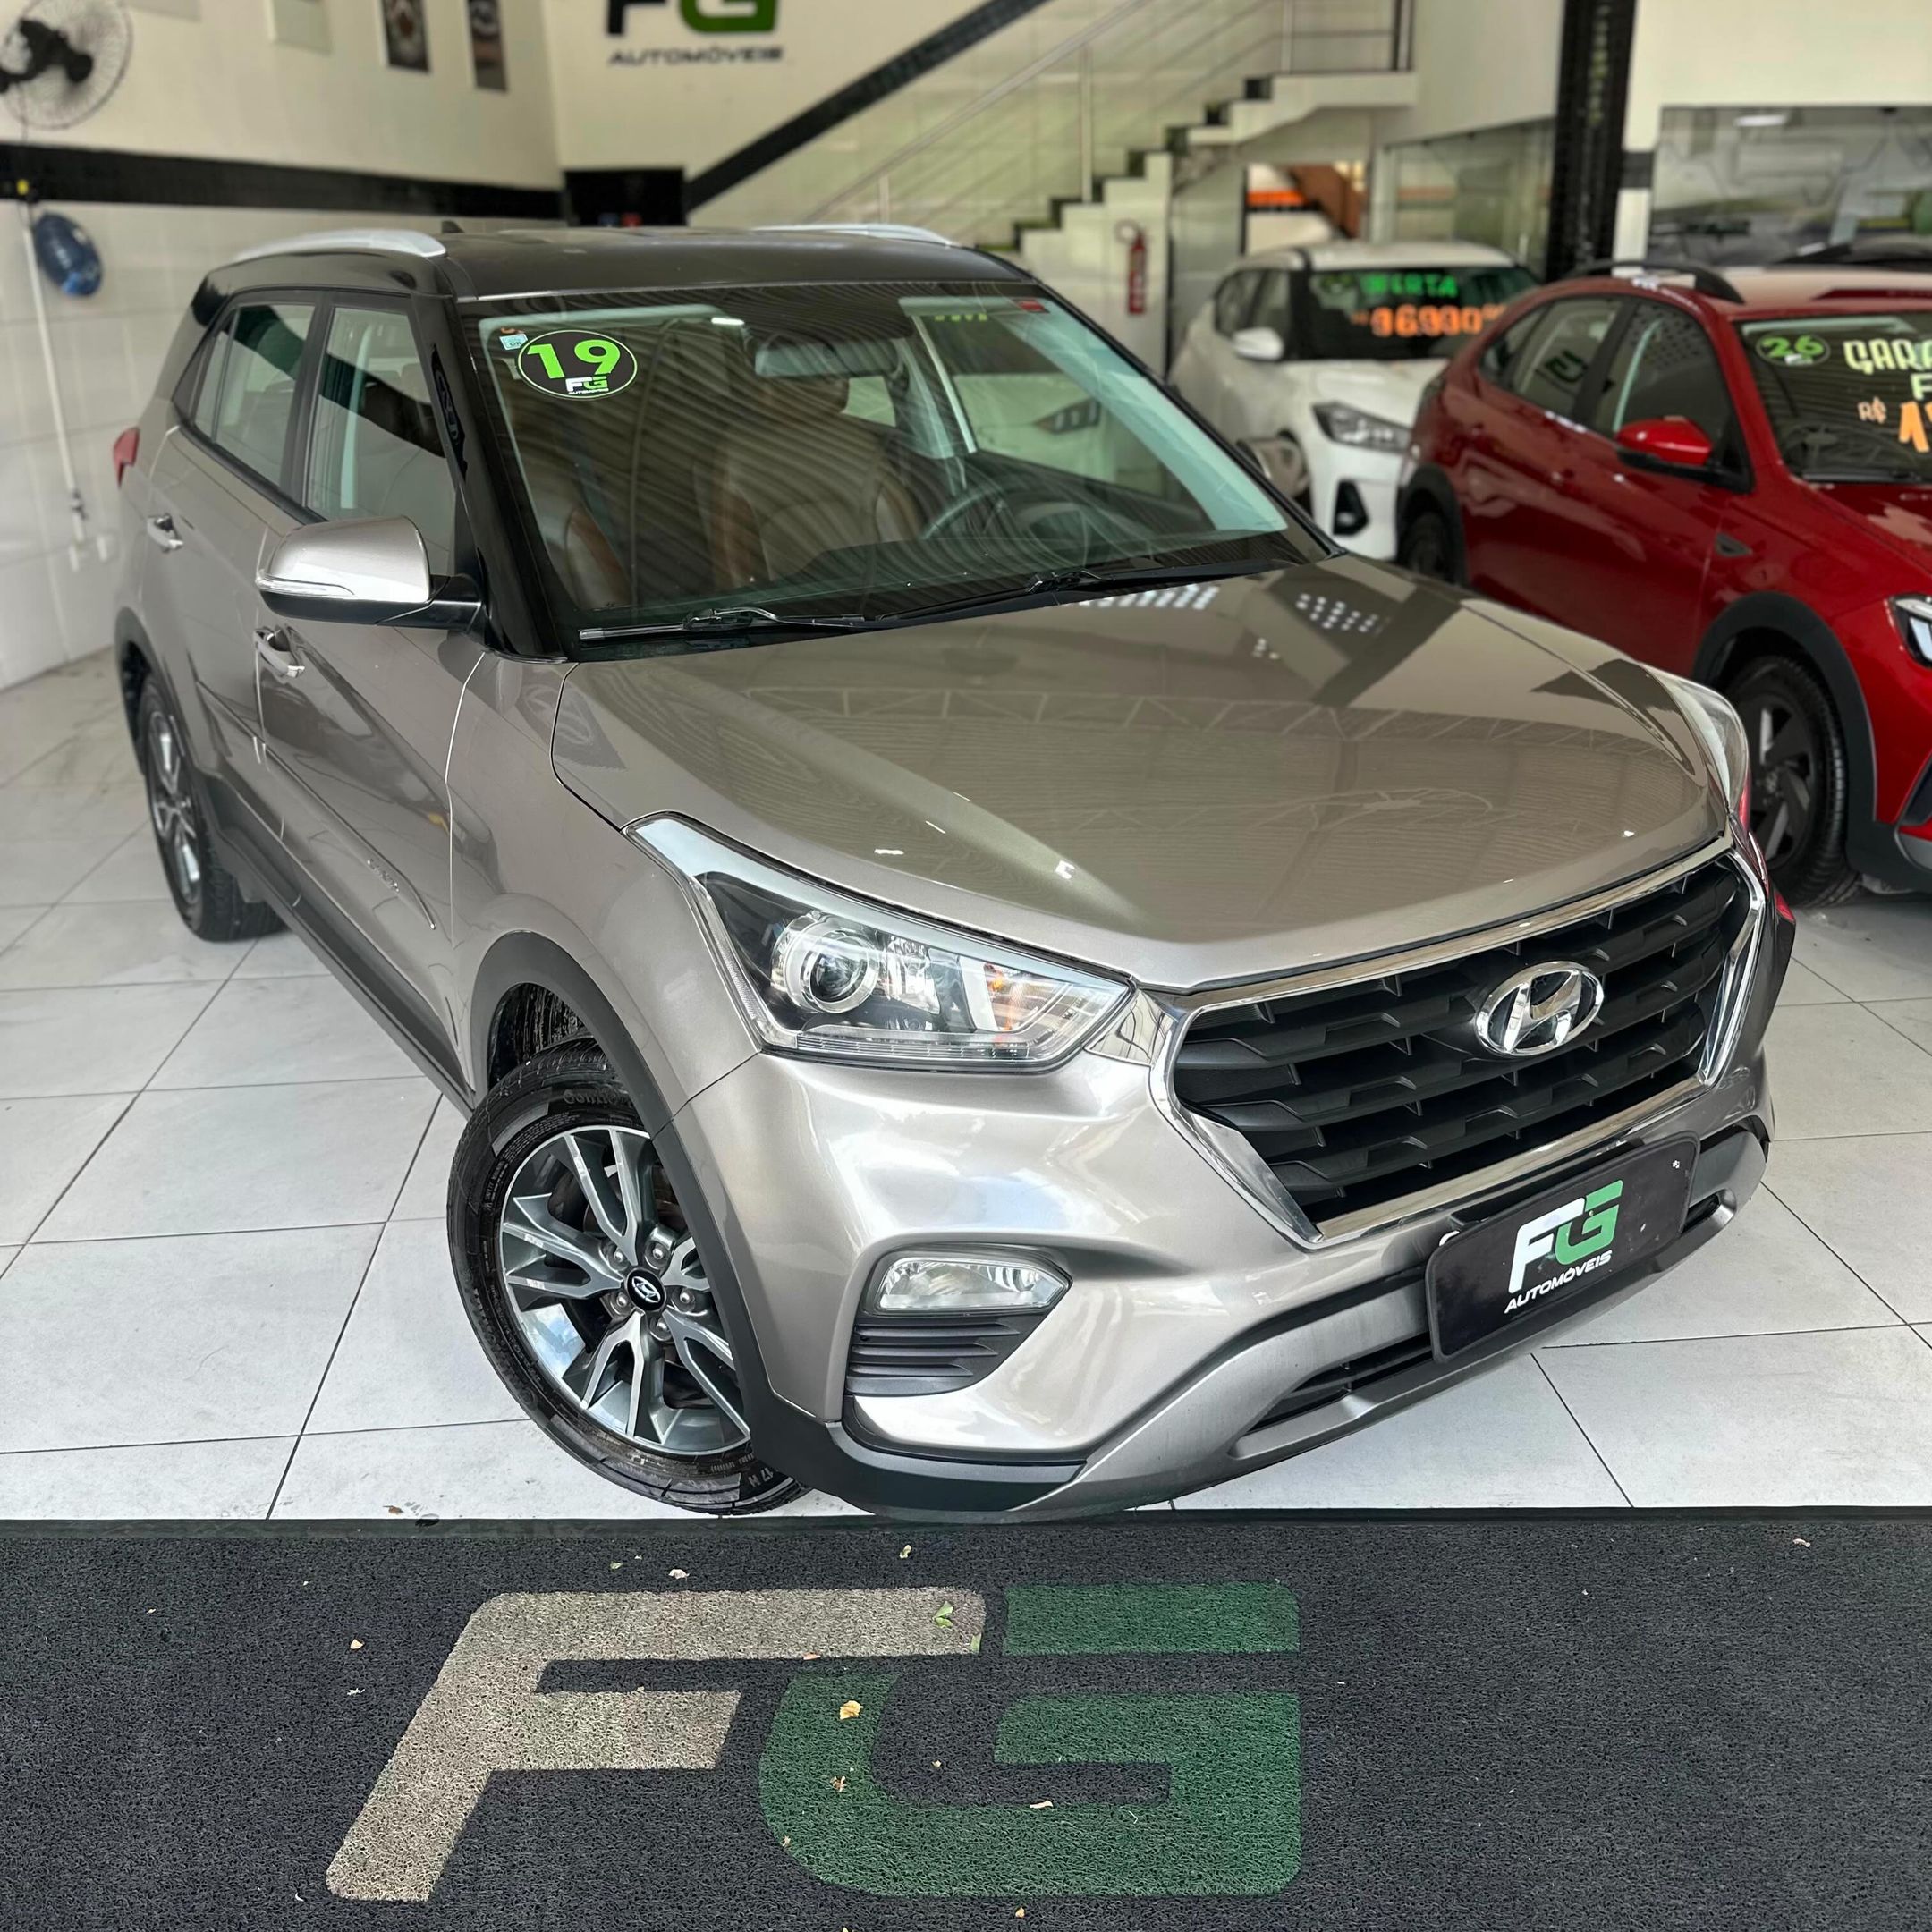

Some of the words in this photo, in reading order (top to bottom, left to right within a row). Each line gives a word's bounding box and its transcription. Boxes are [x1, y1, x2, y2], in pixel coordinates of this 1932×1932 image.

[527, 339, 621, 379] 19
[1760, 335, 1825, 358] 26
[565, 376, 608, 392] FG
[1857, 396, 1887, 424] R$
[1897, 401, 1932, 453] 1
[1508, 1179, 1623, 1294] FG
[1504, 1250, 1613, 1315] AUTOMÓVEIS
[326, 1582, 1301, 1902] FG
